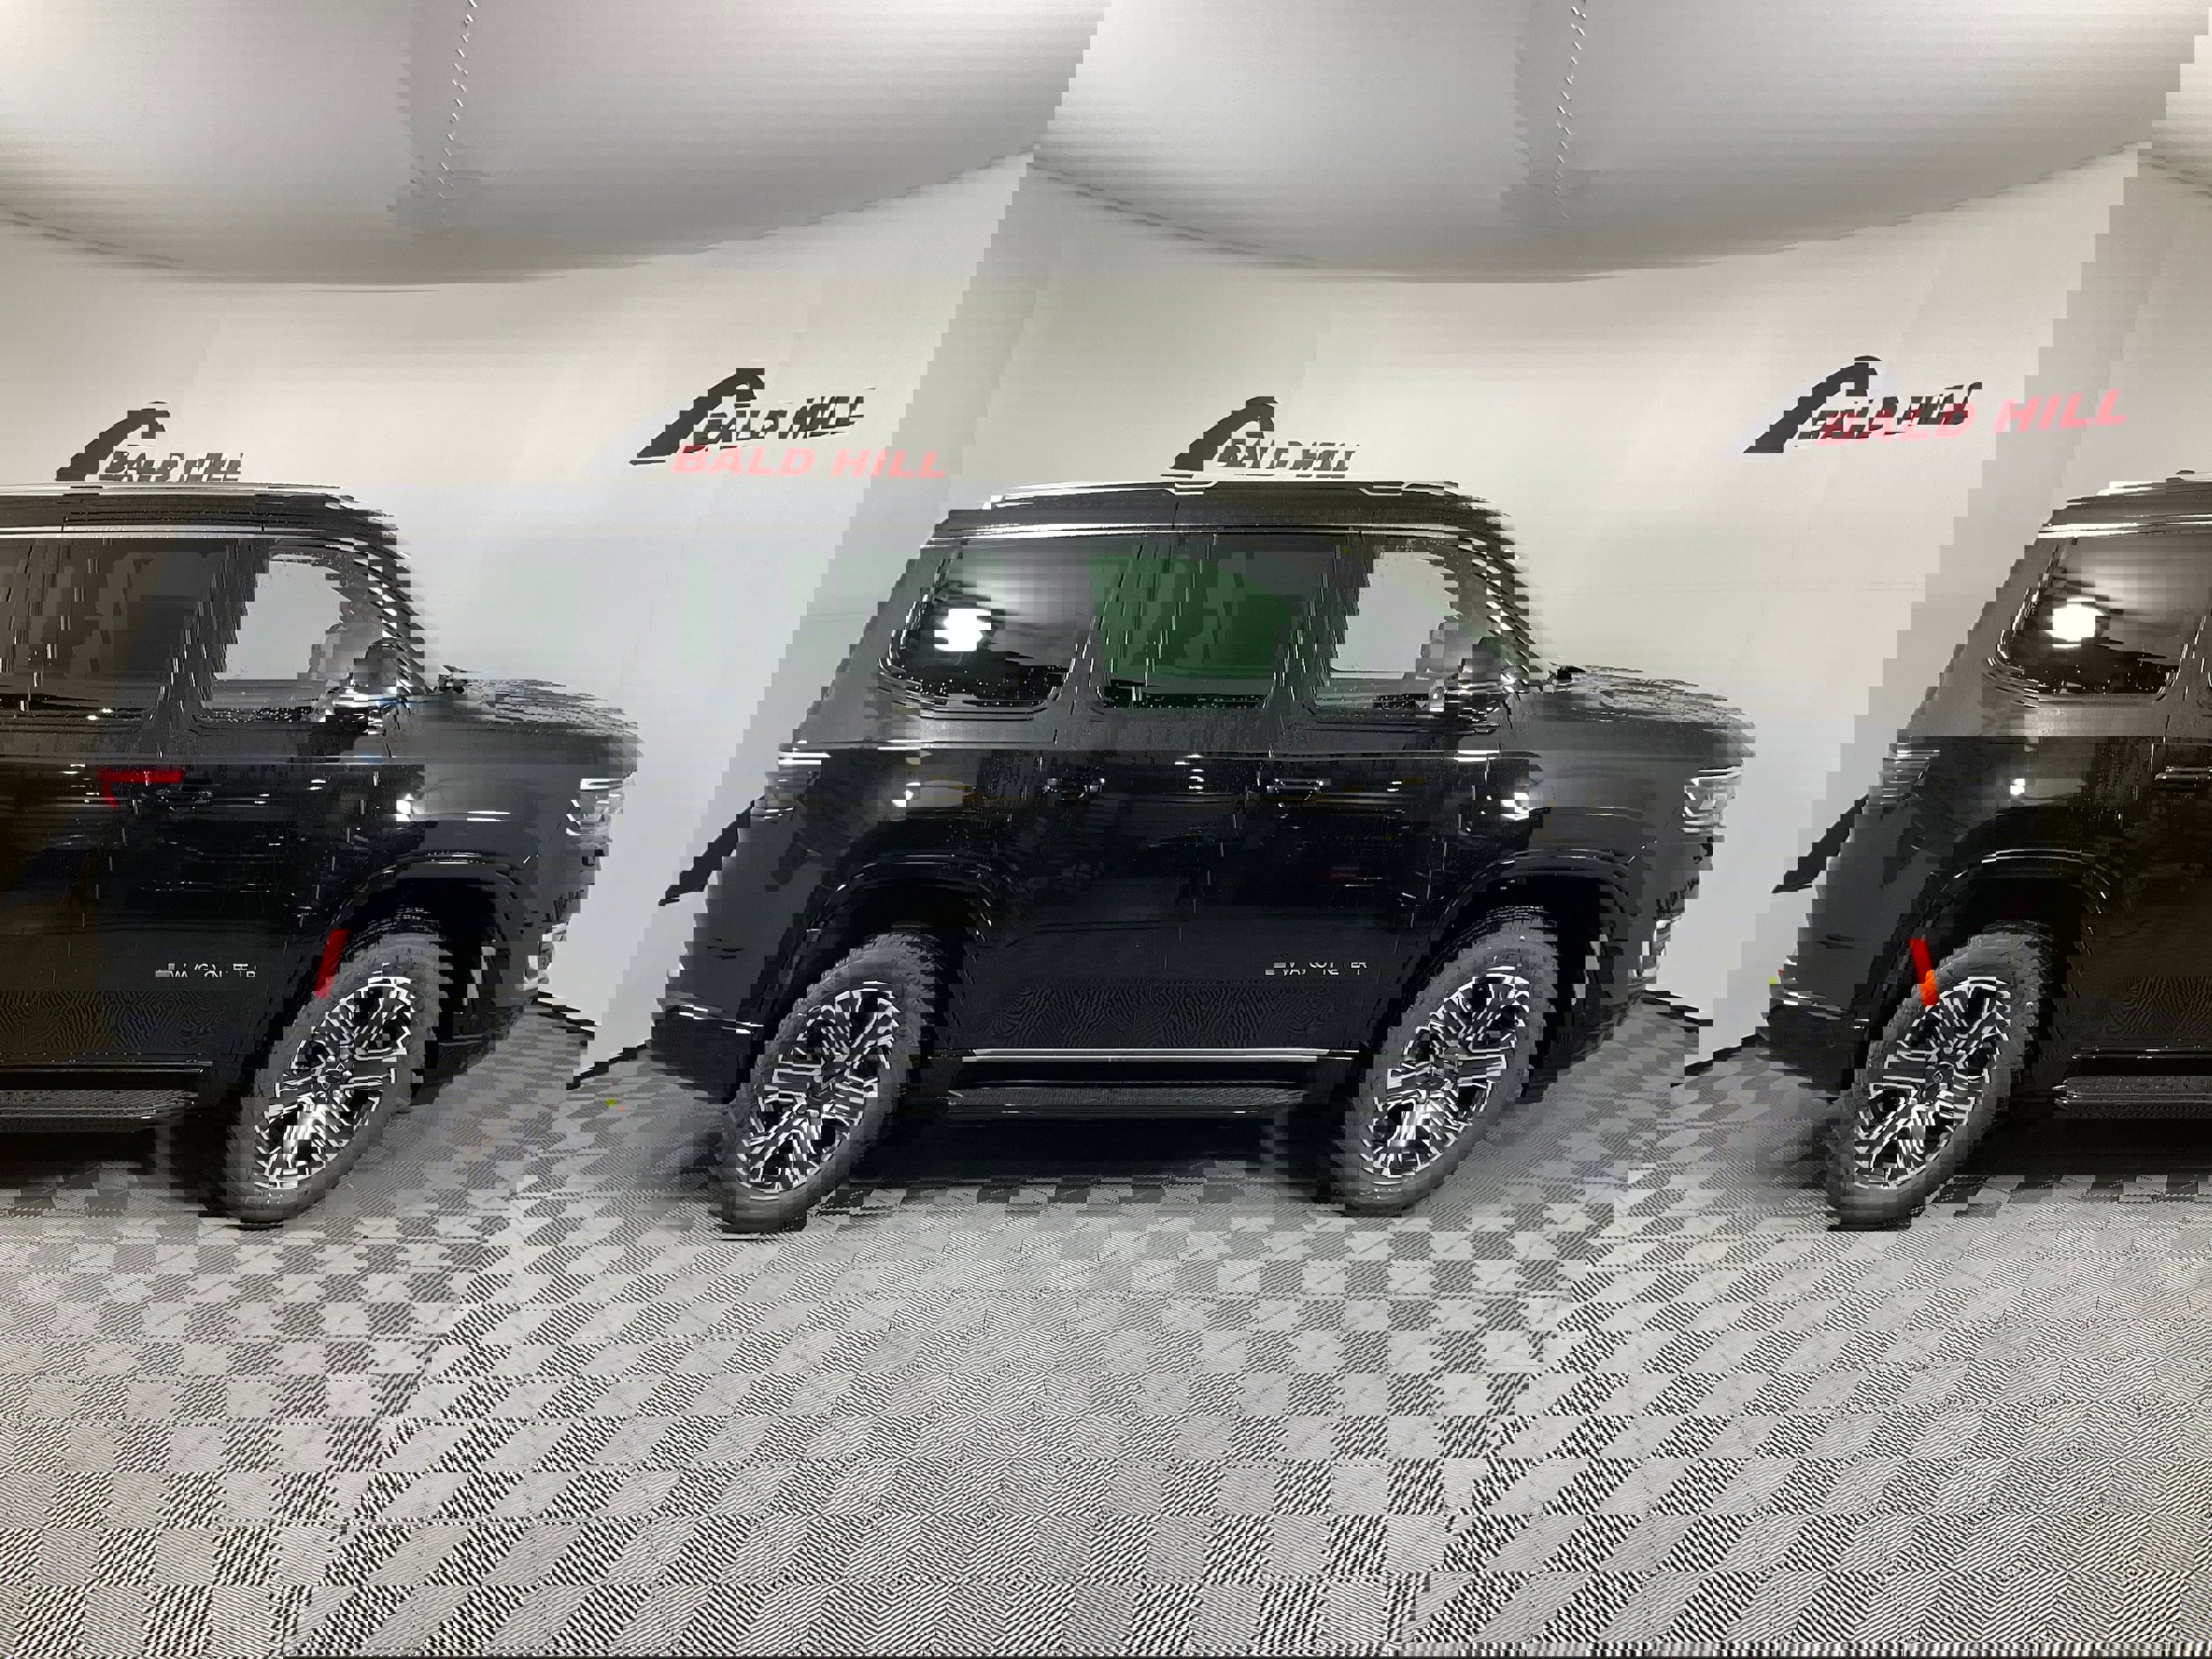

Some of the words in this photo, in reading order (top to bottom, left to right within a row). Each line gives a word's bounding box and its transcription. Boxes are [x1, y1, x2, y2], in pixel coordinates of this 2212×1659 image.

[1816, 402, 1977, 446] BALD
[1992, 388, 2128, 434] HILL
[671, 444, 815, 476] BALD
[830, 449, 945, 479] HILL
